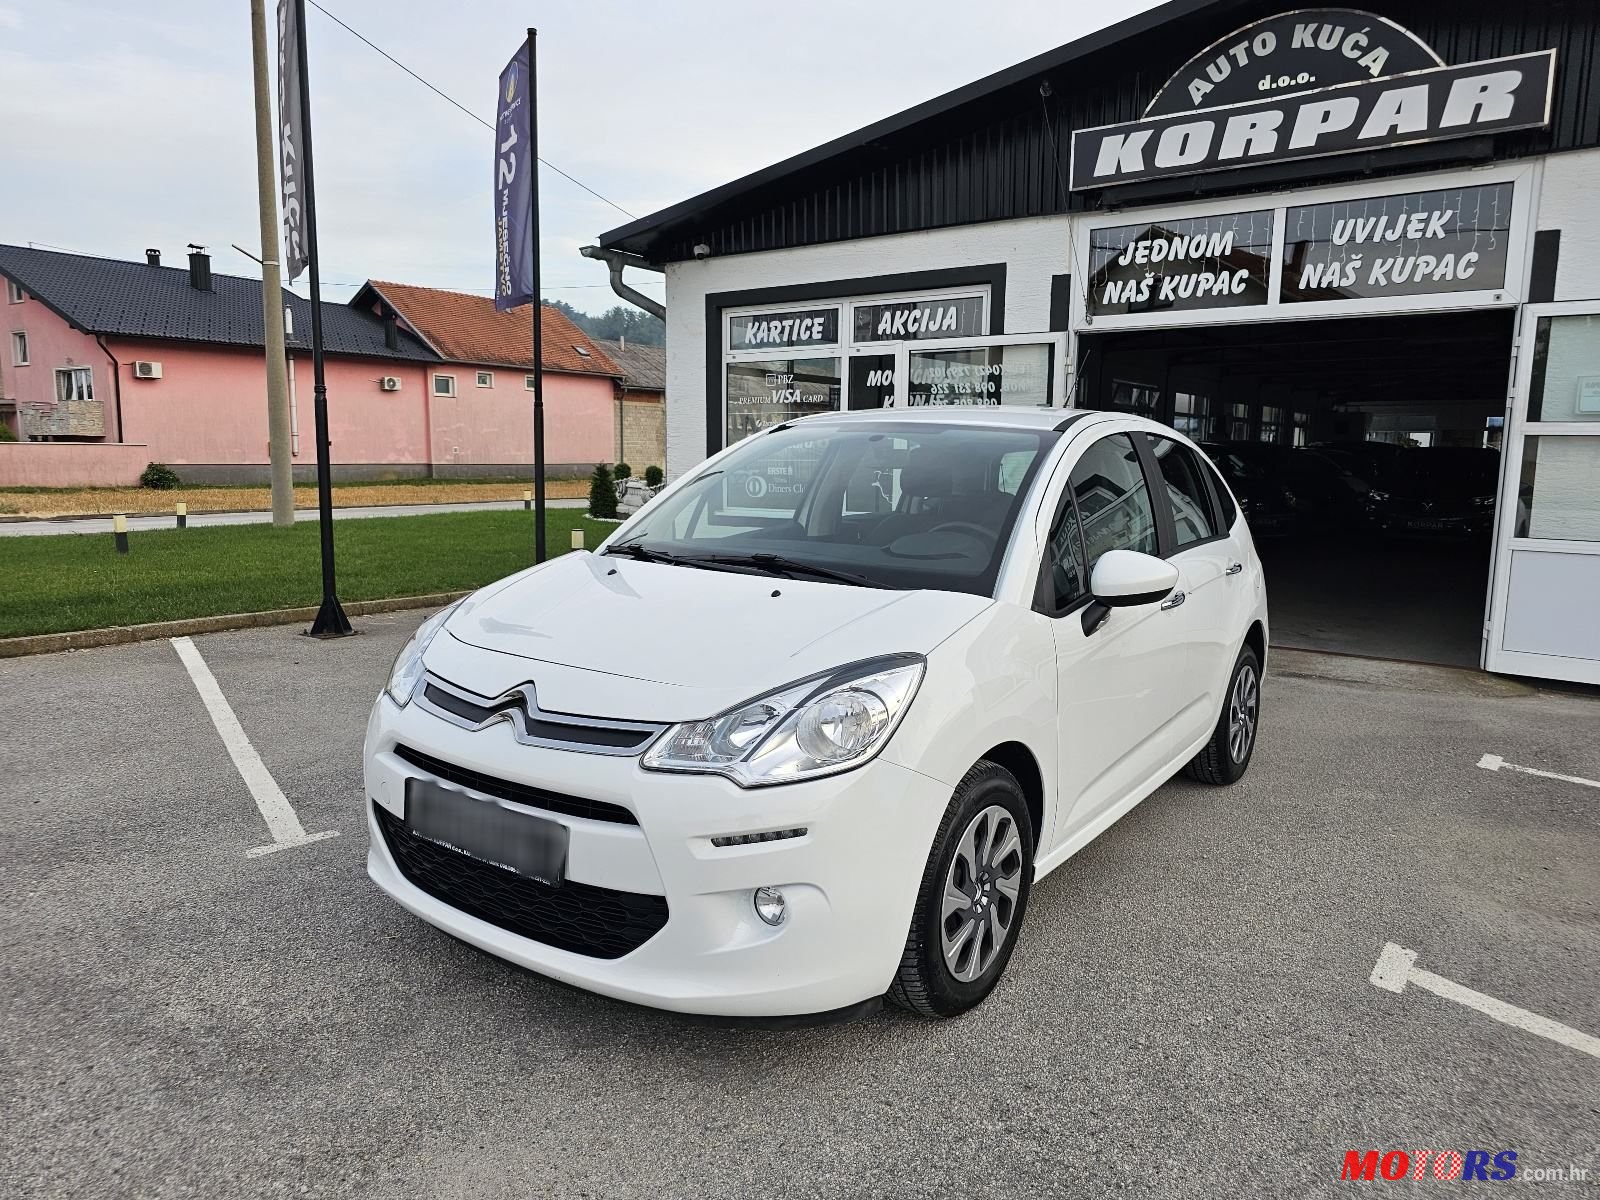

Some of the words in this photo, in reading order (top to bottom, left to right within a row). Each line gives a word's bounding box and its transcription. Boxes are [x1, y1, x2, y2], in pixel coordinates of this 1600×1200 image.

[1186, 30, 1277, 106] AUTO
[1291, 22, 1391, 77] KUĆA
[1257, 73, 1316, 92] d.o.o.
[1093, 69, 1523, 177] KORPAR
[498, 123, 518, 191] 12
[1332, 209, 1454, 247] UVIJEK
[497, 216, 507, 297] JAMSTVO
[1118, 230, 1234, 267] JEDNOM
[1102, 275, 1155, 305] NAŠ
[1158, 268, 1250, 302] KUPAC
[1297, 254, 1362, 290] NAŠ
[1367, 251, 1480, 287] KUPAC
[744, 317, 825, 345] KARTICE
[877, 306, 957, 336] AKCIJA
[739, 396, 771, 405] PREMIUM
[771, 389, 801, 404] VISA
[802, 395, 824, 403] CARD
[777, 374, 794, 385] PBZ
[767, 467, 788, 475] ERSTE
[768, 483, 791, 493] Diners
